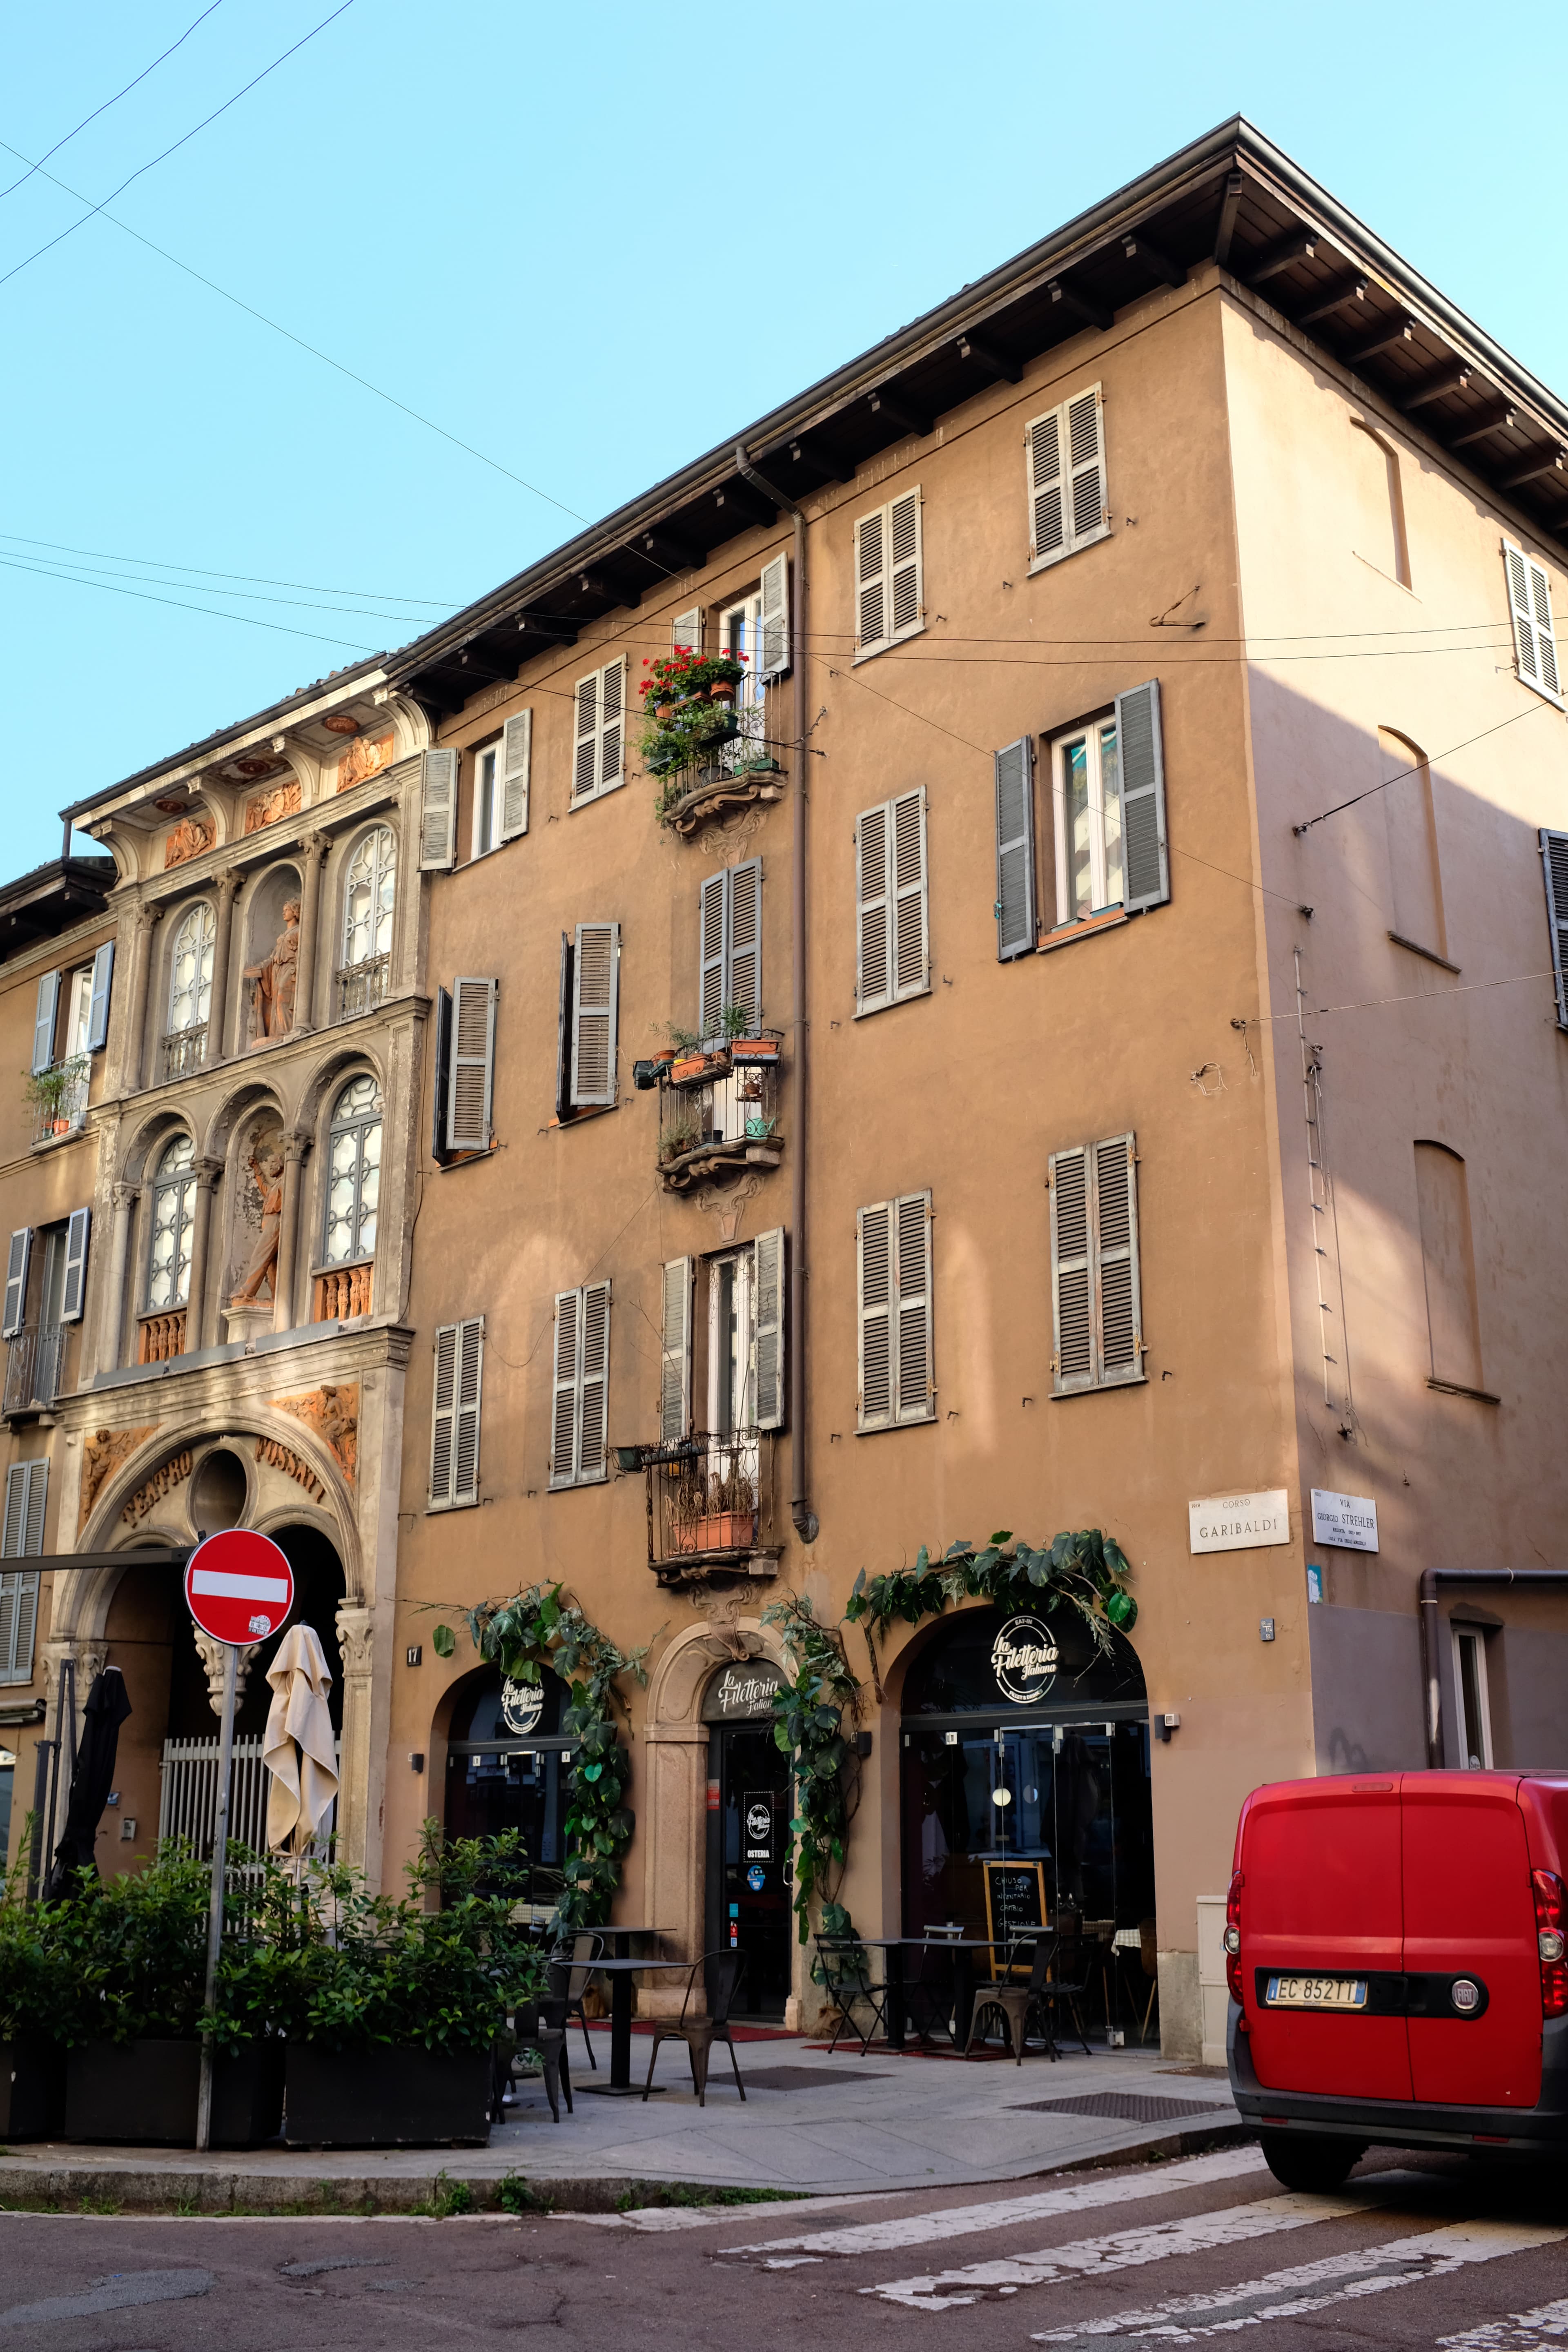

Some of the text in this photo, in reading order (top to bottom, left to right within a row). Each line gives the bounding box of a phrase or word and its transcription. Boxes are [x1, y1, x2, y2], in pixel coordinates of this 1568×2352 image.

[123, 1437, 325, 1528] TEATRO FOSSATI
[1223, 1499, 1250, 1508] CORSO
[1340, 1499, 1350, 1508] VIA
[1200, 1519, 1277, 1538] GARIBALDI
[1317, 1512, 1374, 1529] GIORGIO STREHLER
[409, 1648, 417, 1662] 17
[991, 1644, 1059, 1677] Filetteria
[718, 1670, 738, 1689] La
[1021, 1663, 1058, 1681] Italiana
[501, 1686, 545, 1713] Filetteria
[718, 1677, 778, 1713] Filetteria
[747, 1850, 770, 1858] OSTERIA
[995, 1877, 1022, 1885] CHIUSO
[998, 1918, 1036, 1927] GESTIONE
[1278, 1979, 1298, 1998] EC
[1304, 1979, 1355, 2000] 852TT
[1457, 1988, 1472, 2002] FIAT
